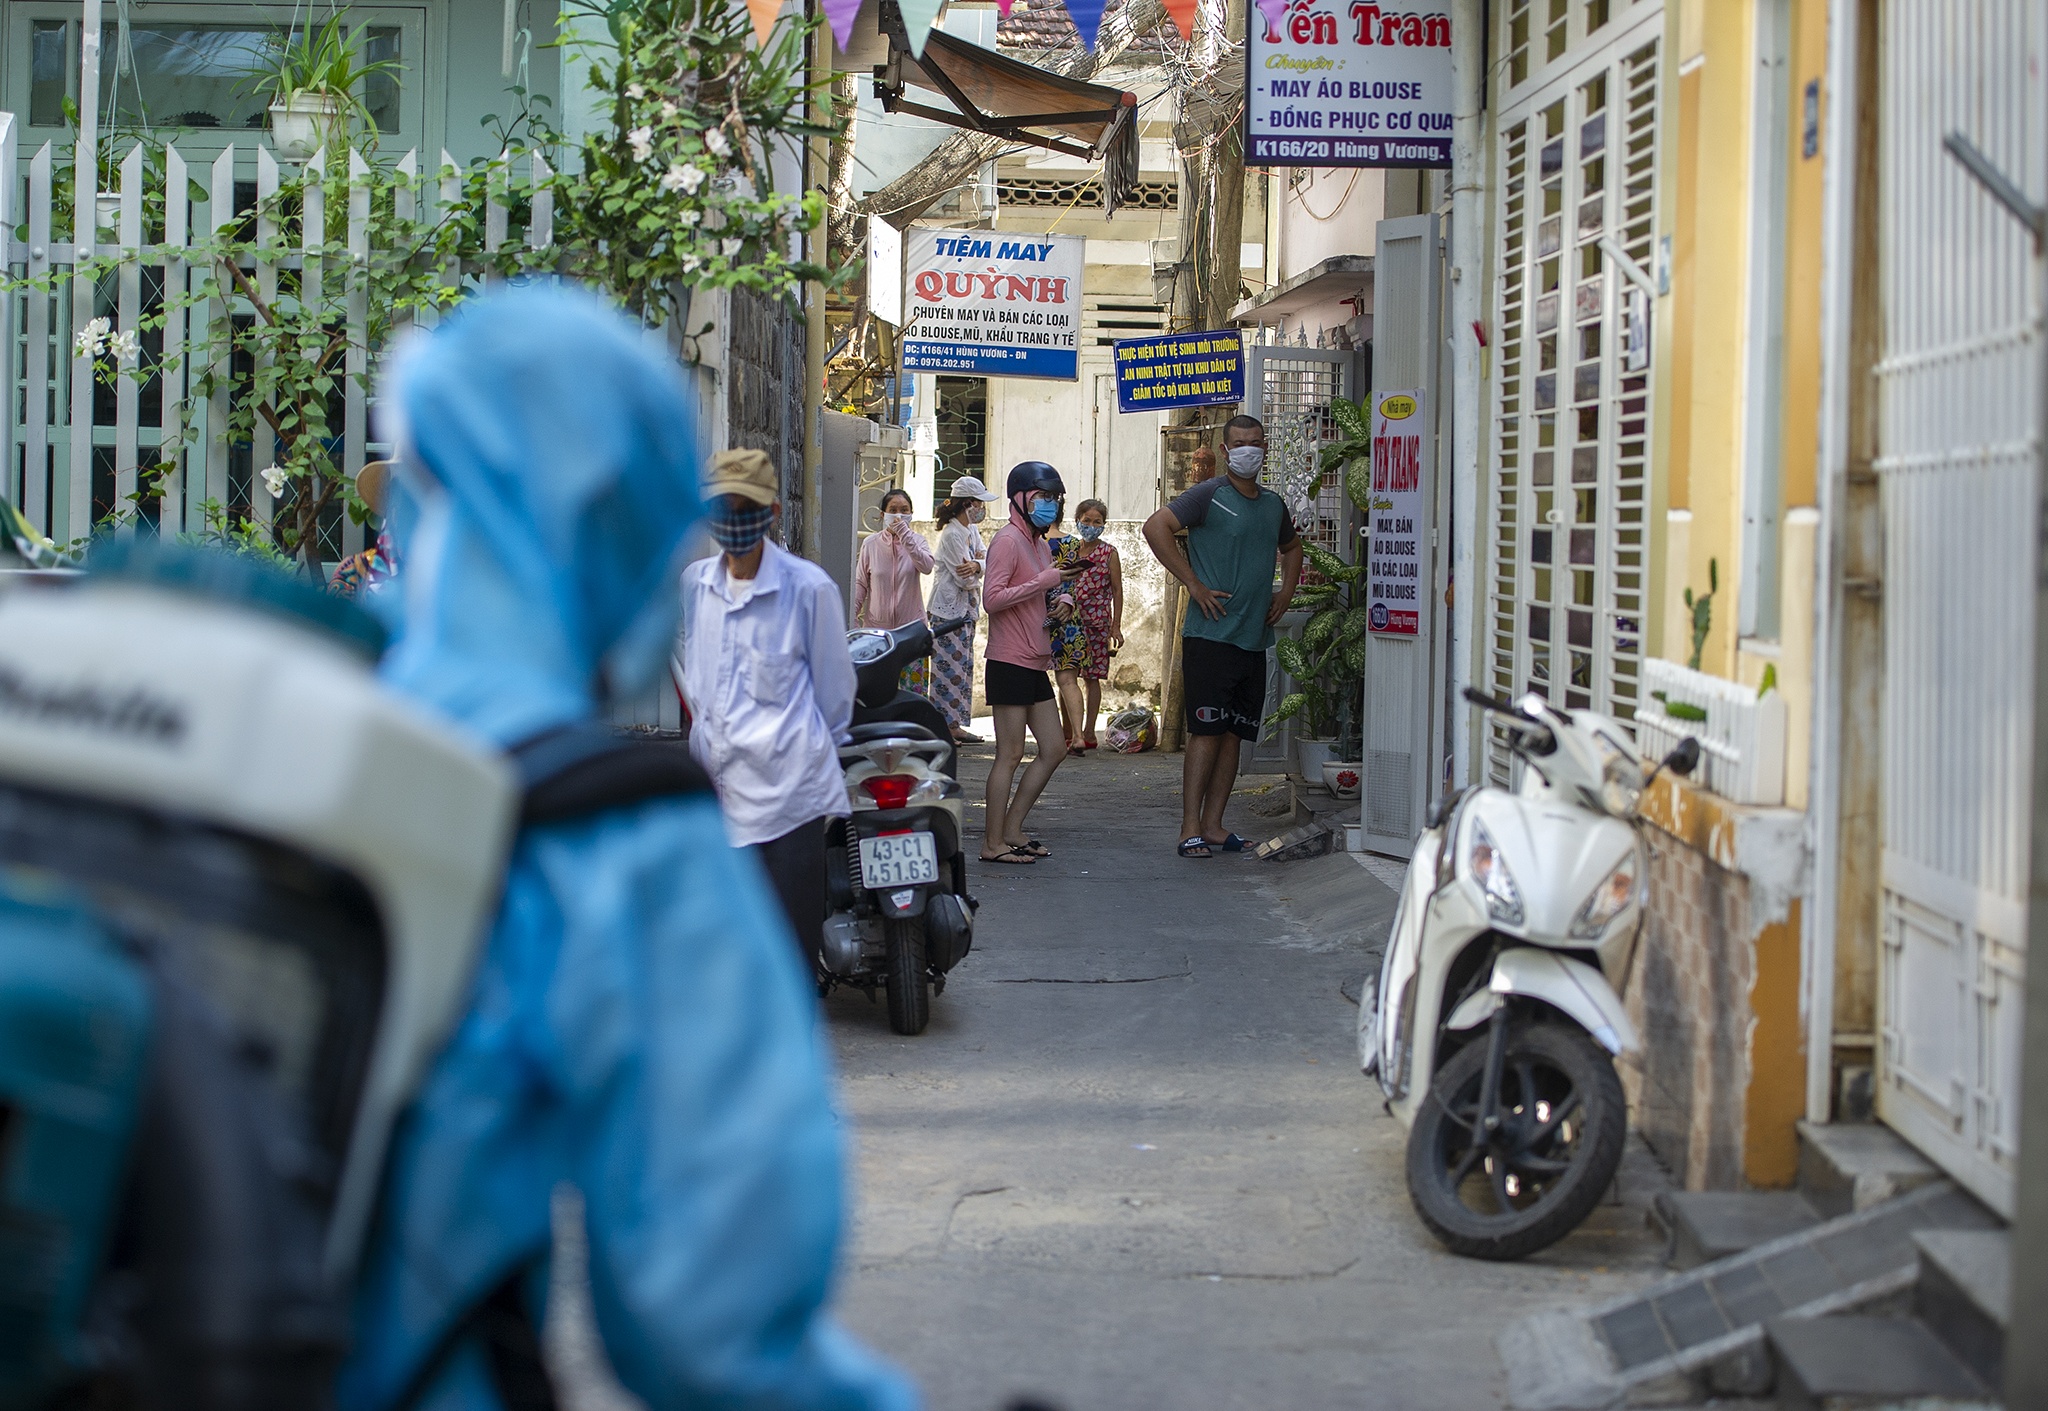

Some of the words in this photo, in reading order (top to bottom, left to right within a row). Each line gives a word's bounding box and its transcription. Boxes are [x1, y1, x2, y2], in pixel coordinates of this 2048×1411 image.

[1265, 54, 1334, 74] Chuyên
[1270, 80, 1311, 98] MAY
[1317, 77, 1342, 99] ÁO
[1349, 81, 1422, 100] BLOUSE
[1329, 112, 1379, 133] PHỤC
[1387, 110, 1412, 130] CƠ
[1256, 140, 1329, 158] K166/20
[1334, 141, 1379, 160] Hùng
[935, 234, 992, 262] TIỆM
[997, 242, 1055, 262] MAY
[914, 265, 1070, 304] QUỲNH
[913, 305, 954, 320] CHUYÊN
[957, 309, 979, 321] MAY
[982, 307, 995, 322] VÀ
[999, 309, 1019, 324] BÁN
[1022, 310, 1043, 325] CÁC
[1046, 313, 1069, 329] LOẠI
[986, 325, 1013, 343] KHẨU
[1017, 331, 1050, 345] TRANG
[1053, 333, 1059, 345] Y
[1062, 330, 1076, 346] TẾ
[905, 344, 920, 354] ĐC:
[921, 345, 953, 356] K166/41
[956, 346, 978, 357] HÙNG
[980, 348, 1008, 359] VƯƠNG
[1015, 350, 1027, 360] ĐN
[1138, 344, 1155, 361] HIỆN
[1155, 340, 1168, 358] TỐT
[1179, 342, 1197, 357] SINH
[1197, 338, 1211, 354] MÔI
[920, 357, 975, 369] 0976.202.951
[1136, 366, 1154, 379] NINH
[1154, 362, 1172, 380] TRẬT
[1183, 362, 1194, 378] TẠI
[1195, 361, 1209, 374] KHU
[1210, 358, 1225, 373] DÂN
[1226, 358, 1236, 371] CƯ
[1133, 383, 1151, 400] GIẢM
[1152, 381, 1166, 398] TỐC
[1178, 383, 1190, 396] KHI
[1191, 382, 1201, 395] RA
[1201, 379, 1215, 394] VÀO
[1217, 378, 1231, 395] KIỆT
[1373, 418, 1390, 492] YẾN
[1391, 435, 1419, 492] TRANG
[1377, 518, 1393, 534] MAY,
[1395, 515, 1412, 533] BÁN
[1374, 537, 1383, 555] ÁO
[1385, 540, 1415, 556] BLOUSE
[1372, 558, 1380, 576] VÀ
[1382, 559, 1397, 577] CÁC
[1399, 563, 1418, 581] LOẠI
[1373, 581, 1384, 598] MŨ
[1385, 584, 1416, 600] BLOUSE
[872, 837, 922, 861] 43-C1
[869, 858, 932, 884] 451.63
